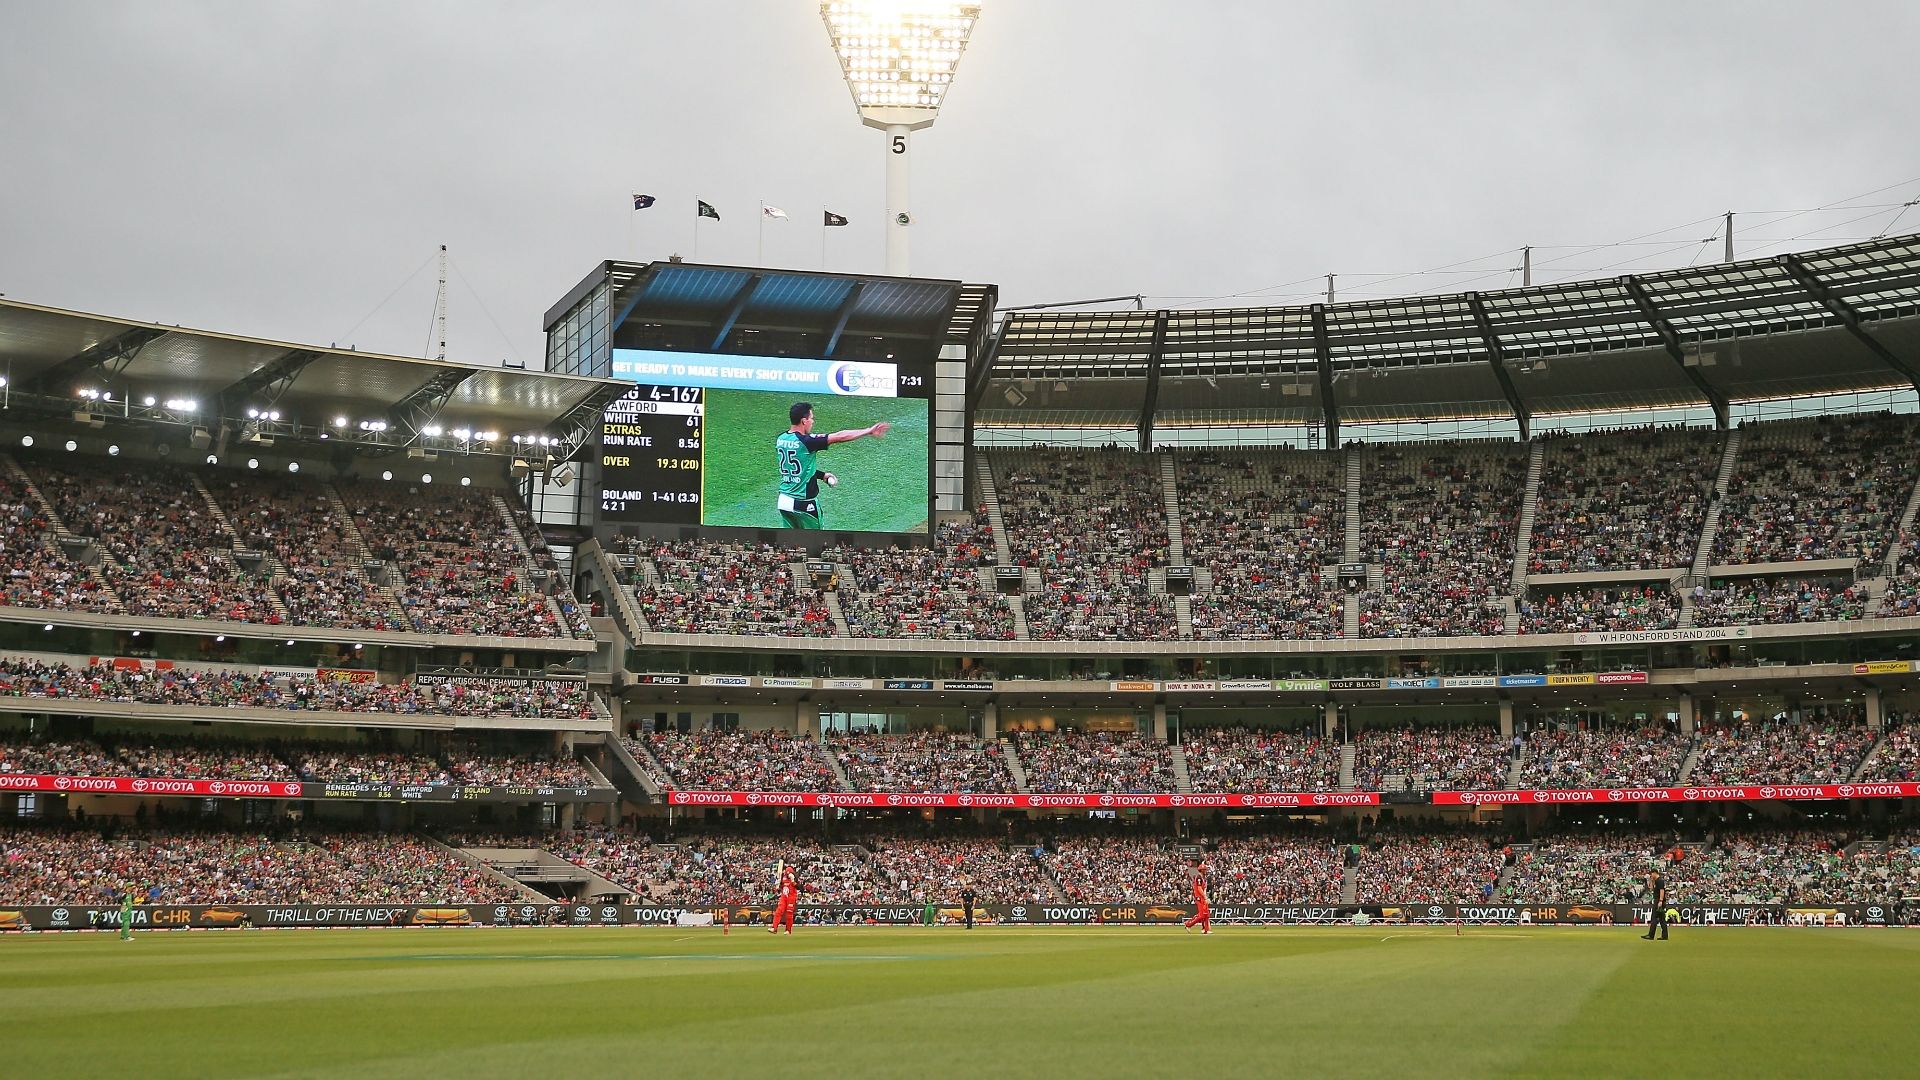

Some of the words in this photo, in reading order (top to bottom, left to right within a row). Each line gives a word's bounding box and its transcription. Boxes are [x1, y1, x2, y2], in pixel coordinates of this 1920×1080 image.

[892, 135, 906, 154] 5
[613, 361, 632, 373] GET
[635, 363, 668, 375] READY
[671, 364, 686, 376] TO
[687, 365, 719, 377] MAKE
[721, 366, 754, 379] EVERY
[756, 368, 784, 380] SHOT
[786, 370, 820, 382] COUNT
[842, 369, 895, 390] Extra
[901, 375, 922, 386] 7:31
[607, 401, 658, 413] AWFORD
[693, 405, 700, 414] 4
[603, 413, 639, 424] WHITE
[686, 416, 699, 427] 61
[603, 424, 642, 435] EXTRAS
[693, 428, 700, 438] 6
[603, 435, 625, 446] RUN
[627, 436, 652, 447] RATE
[678, 438, 700, 449] 8.56
[603, 456, 630, 467] OVER
[656, 458, 678, 469] 19.3
[681, 459, 699, 470] (20)
[778, 447, 802, 477] 25
[602, 489, 642, 501] BOLAND
[677, 492, 699, 503] (3.3)
[601, 501, 609, 511] 4
[611, 501, 618, 511] 2
[620, 502, 625, 511] 1
[1599, 634, 1608, 642] W
[1610, 634, 1617, 642] H
[1620, 632, 1670, 642] PONSFORD
[1673, 630, 1703, 640] STAND
[1705, 630, 1726, 639] 2004
[418, 675, 446, 684] REPORT
[652, 676, 680, 684] FUSO
[715, 677, 747, 685] mazda
[1285, 681, 1323, 690] 9mile
[1570, 675, 1590, 683] TWENTY
[0, 776, 39, 788] OYOTA
[72, 779, 118, 790] TOYOTA
[150, 781, 195, 792] TOYOTA
[227, 783, 270, 794] TOYOTA
[325, 784, 369, 792] RENEGADES
[692, 794, 733, 804] TOYOTA
[762, 794, 803, 804] TOYOTA
[833, 795, 874, 805] TOYOTA
[904, 795, 945, 805] TOYOTA
[974, 796, 1015, 806] TOYOTA
[1045, 796, 1086, 805] TOYOTA
[1115, 796, 1157, 805] TOYOTA
[1186, 795, 1228, 805] TOYOTA
[1258, 795, 1299, 804] TOYOTA
[1330, 795, 1371, 804] TOYOTA
[1478, 792, 1520, 802] TOYOTA
[1551, 792, 1594, 801] TOYOTA
[1625, 790, 1670, 800] TOYOTA
[1701, 789, 1745, 798] TOYOTA
[1778, 787, 1823, 797] TOYOTA
[1856, 785, 1902, 796] TOYOTA
[152, 909, 191, 923] C-HR
[266, 909, 313, 922] THRILL
[315, 908, 336, 921] OF
[337, 908, 364, 921] THE
[1102, 908, 1137, 919] C-HR
[1303, 908, 1339, 919] NEXT
